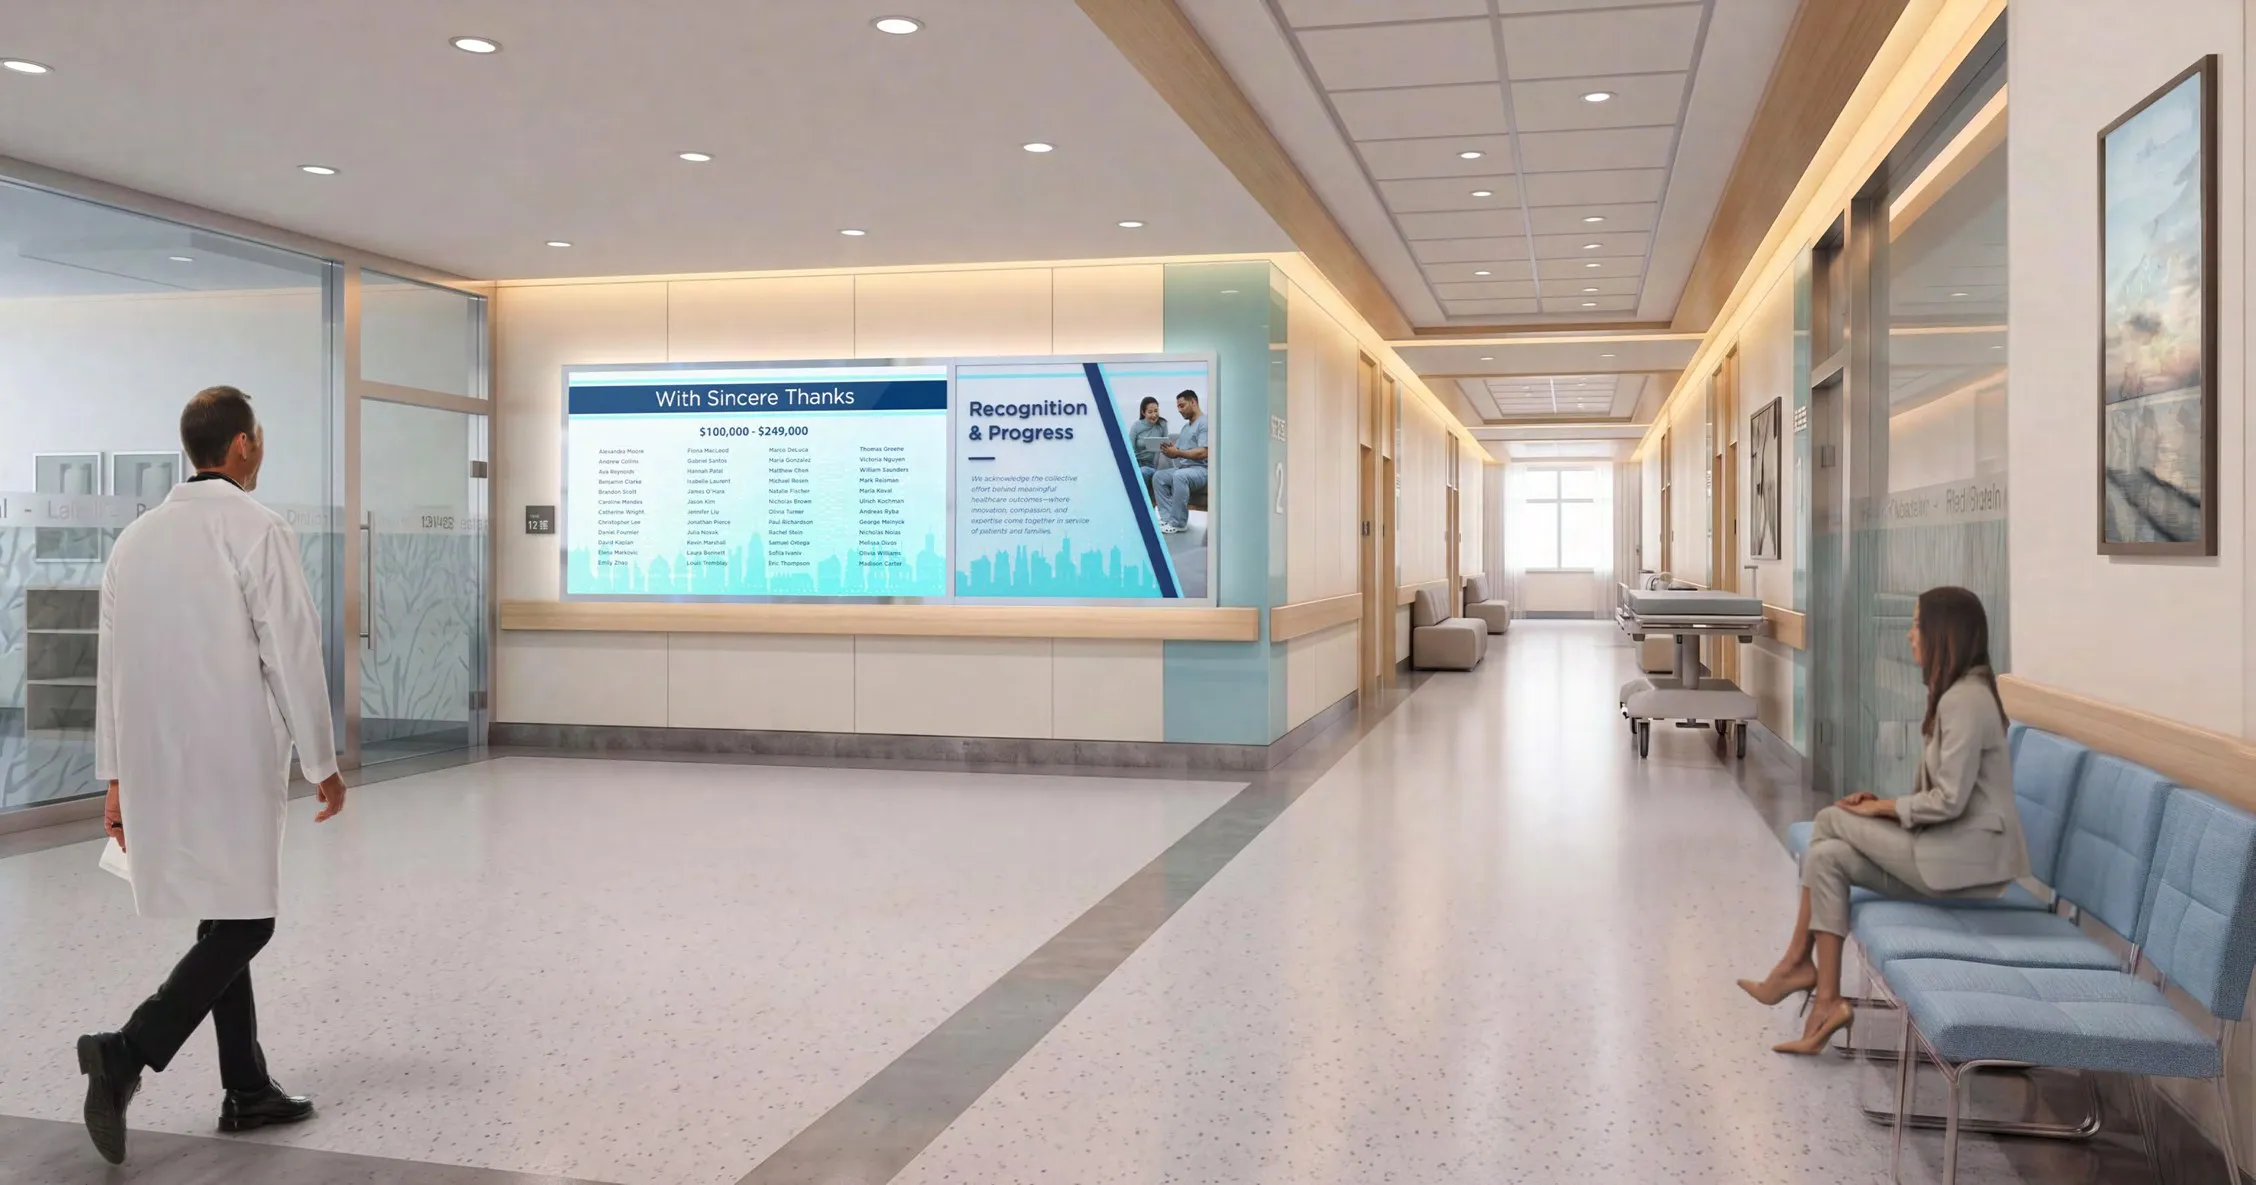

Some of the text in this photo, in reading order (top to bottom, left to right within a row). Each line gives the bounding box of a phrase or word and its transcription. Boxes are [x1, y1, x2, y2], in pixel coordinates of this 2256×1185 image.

[656, 387, 854, 407] With Sincere Thanks
[969, 400, 1088, 418] Recognition
[700, 426, 749, 438] $100,000
[758, 425, 808, 436] $249,000
[969, 425, 1074, 443] & Progress
[528, 520, 538, 530] 12
